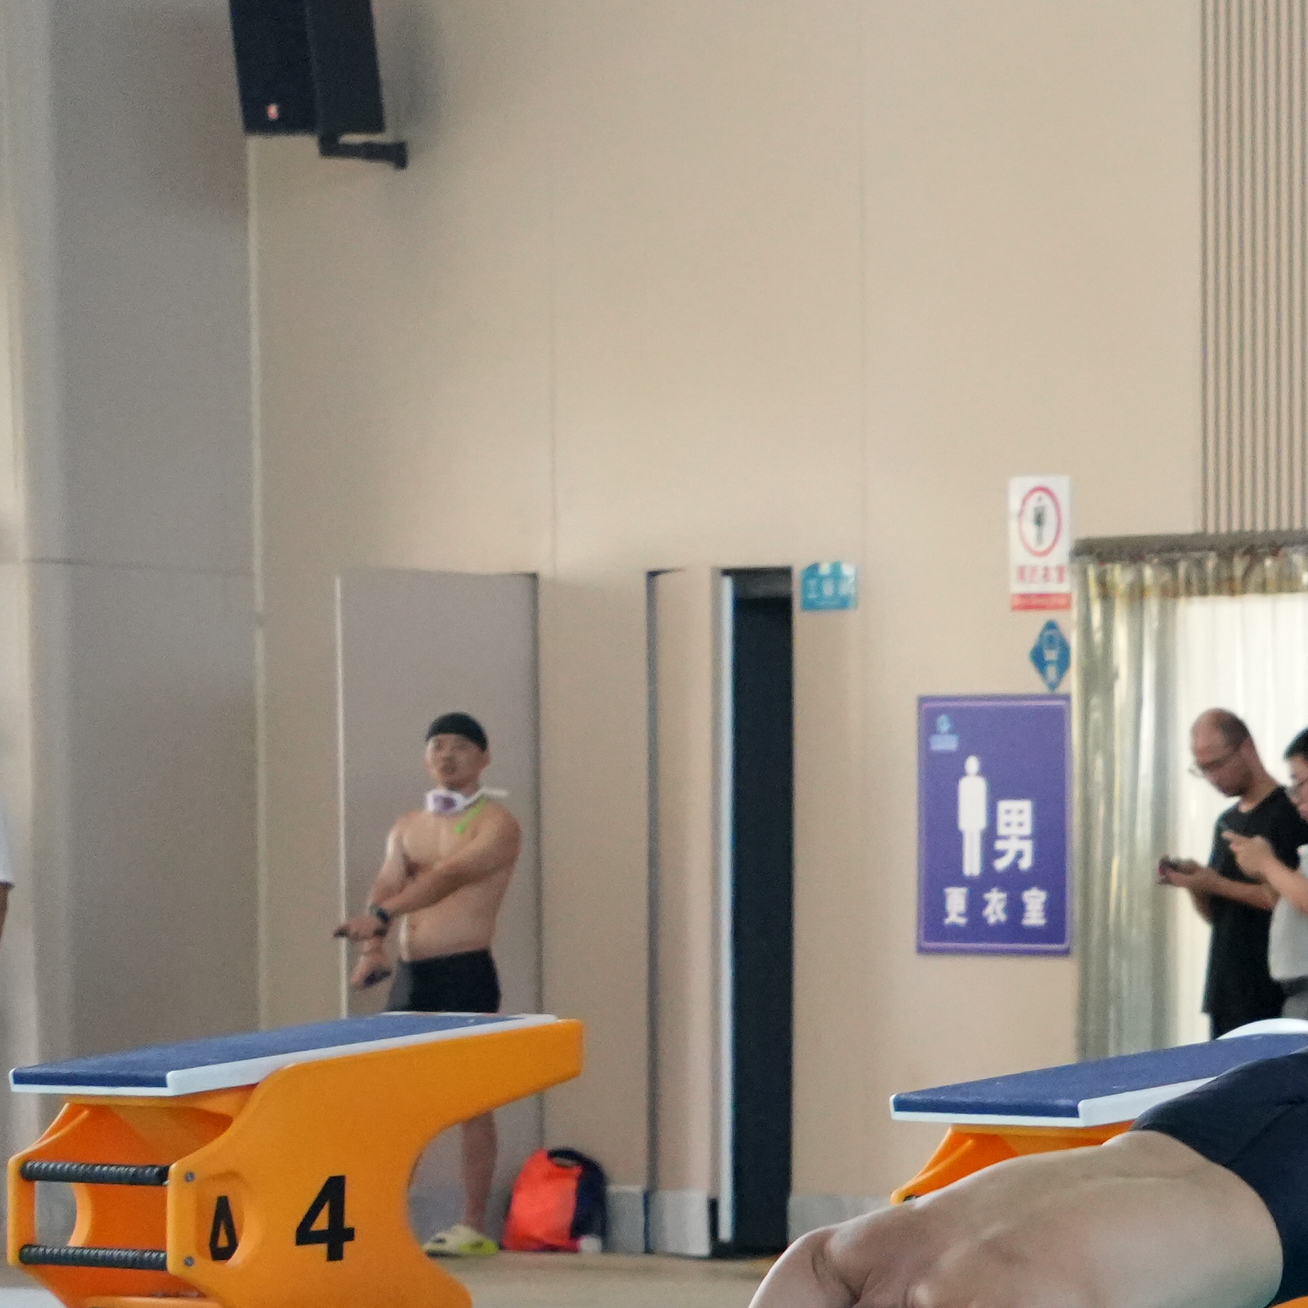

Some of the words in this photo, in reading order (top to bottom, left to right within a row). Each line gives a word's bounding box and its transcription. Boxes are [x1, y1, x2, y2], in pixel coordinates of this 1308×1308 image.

[994, 799, 1034, 872] 男
[943, 886, 1048, 927] 更衣室
[295, 1175, 355, 1262] 4
